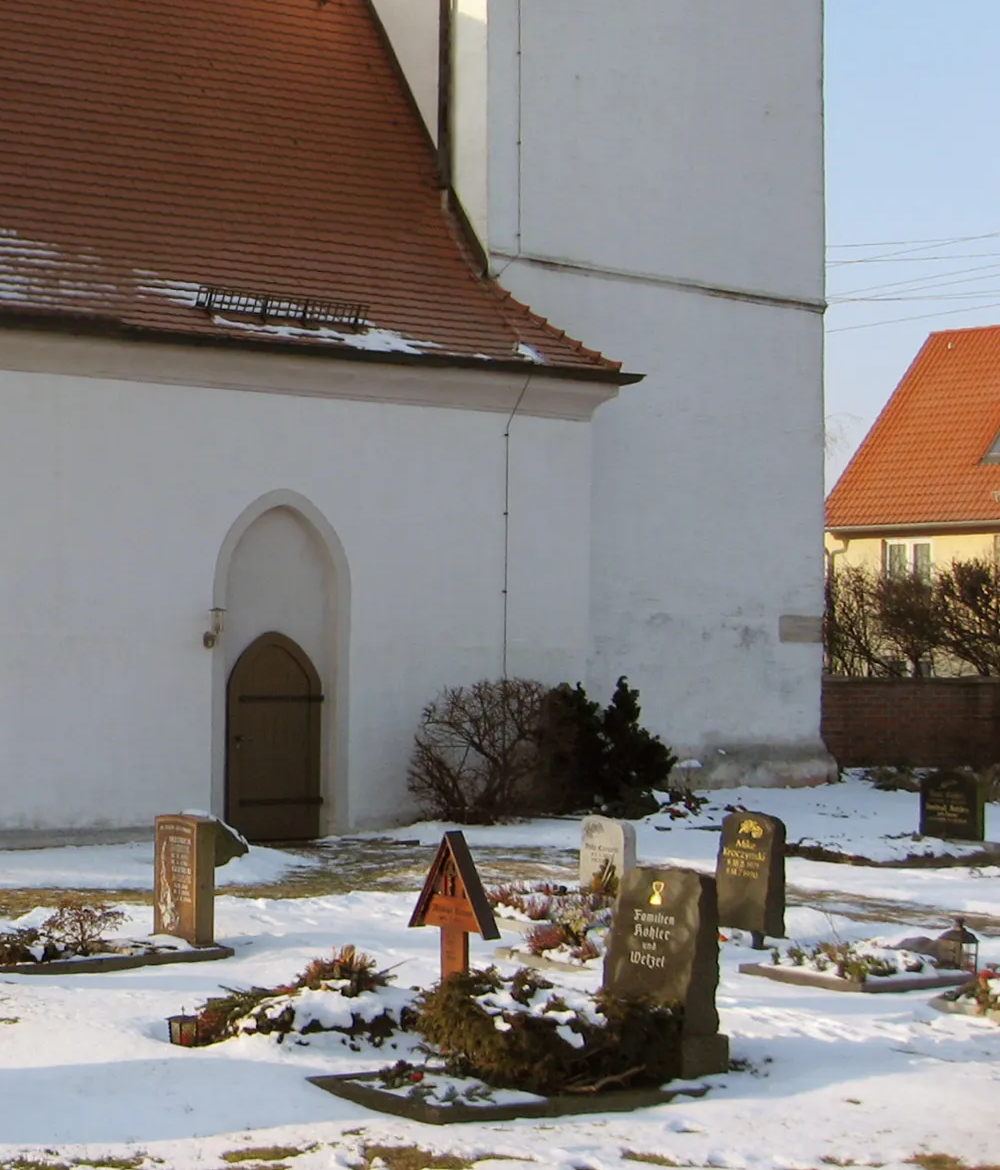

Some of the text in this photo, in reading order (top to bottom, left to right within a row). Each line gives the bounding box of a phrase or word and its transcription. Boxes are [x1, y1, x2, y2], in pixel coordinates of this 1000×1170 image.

[633, 909, 675, 925] Familien
[642, 941, 657, 951] und
[630, 951, 665, 968] Wetzel
